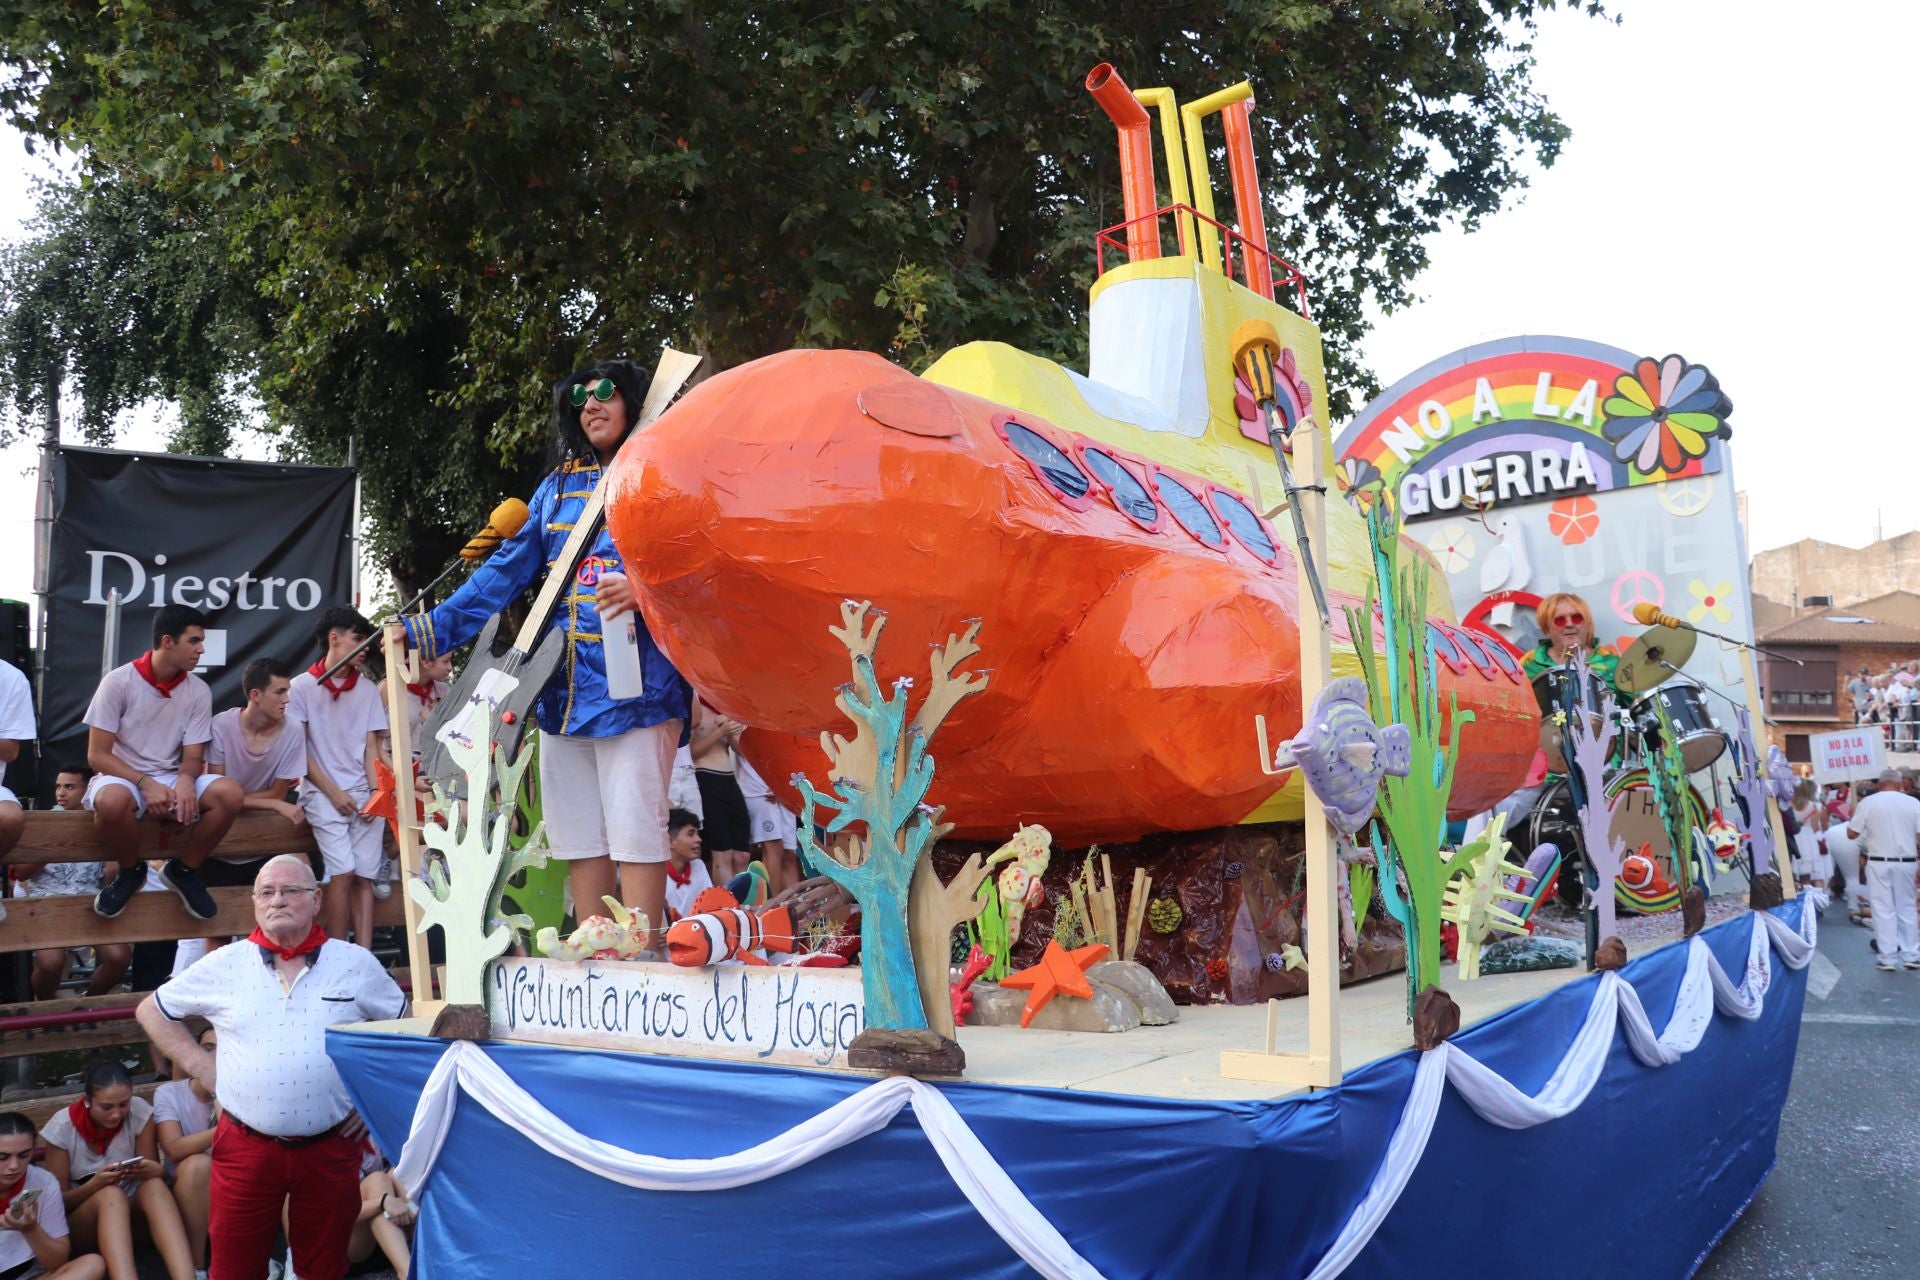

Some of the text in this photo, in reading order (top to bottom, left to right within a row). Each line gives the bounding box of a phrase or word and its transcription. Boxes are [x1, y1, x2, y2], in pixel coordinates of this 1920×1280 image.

[1379, 372, 1599, 465] NO A LA
[1400, 441, 1597, 517] GUERRA
[82, 549, 322, 611] Diestro
[1828, 737, 1863, 751] NO A LA
[1828, 754, 1869, 768] GUERRA
[495, 962, 690, 1039] Voluntarios
[702, 968, 753, 1044] del
